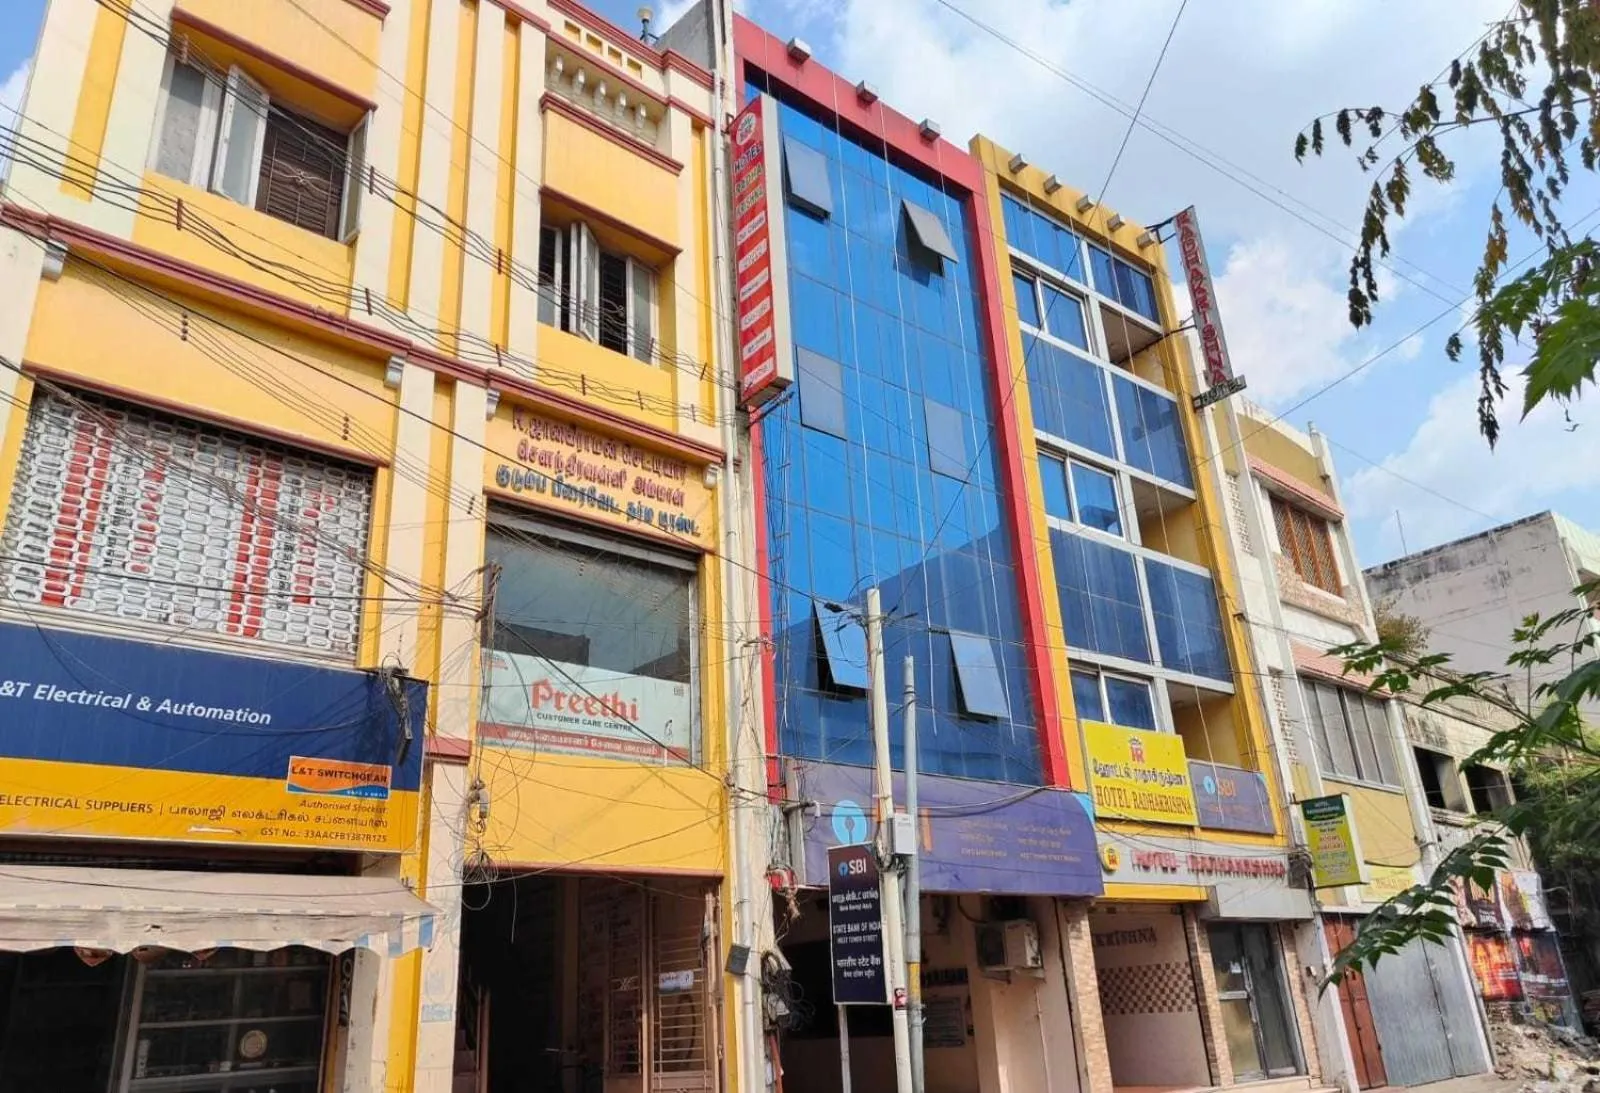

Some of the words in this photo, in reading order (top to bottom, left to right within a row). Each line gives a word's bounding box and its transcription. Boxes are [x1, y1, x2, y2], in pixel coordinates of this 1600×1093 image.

[33, 685, 132, 710] Electrical
[136, 696, 152, 711] &
[157, 698, 272, 725] Automation
[532, 679, 639, 722] Preethi
[537, 712, 580, 725] CUSTOMER
[582, 719, 603, 728] CARE
[604, 722, 633, 732] CENTRE
[291, 766, 315, 776] L&T
[318, 768, 388, 783] SWITCHGEAR
[0, 794, 81, 809] ELECTRICAL
[85, 799, 154, 814] SUPPLIERS
[1095, 784, 1131, 809] HOTEL
[169, 804, 226, 821] பாலாஜி
[260, 827, 278, 836] GST
[848, 858, 867, 874] SBI
